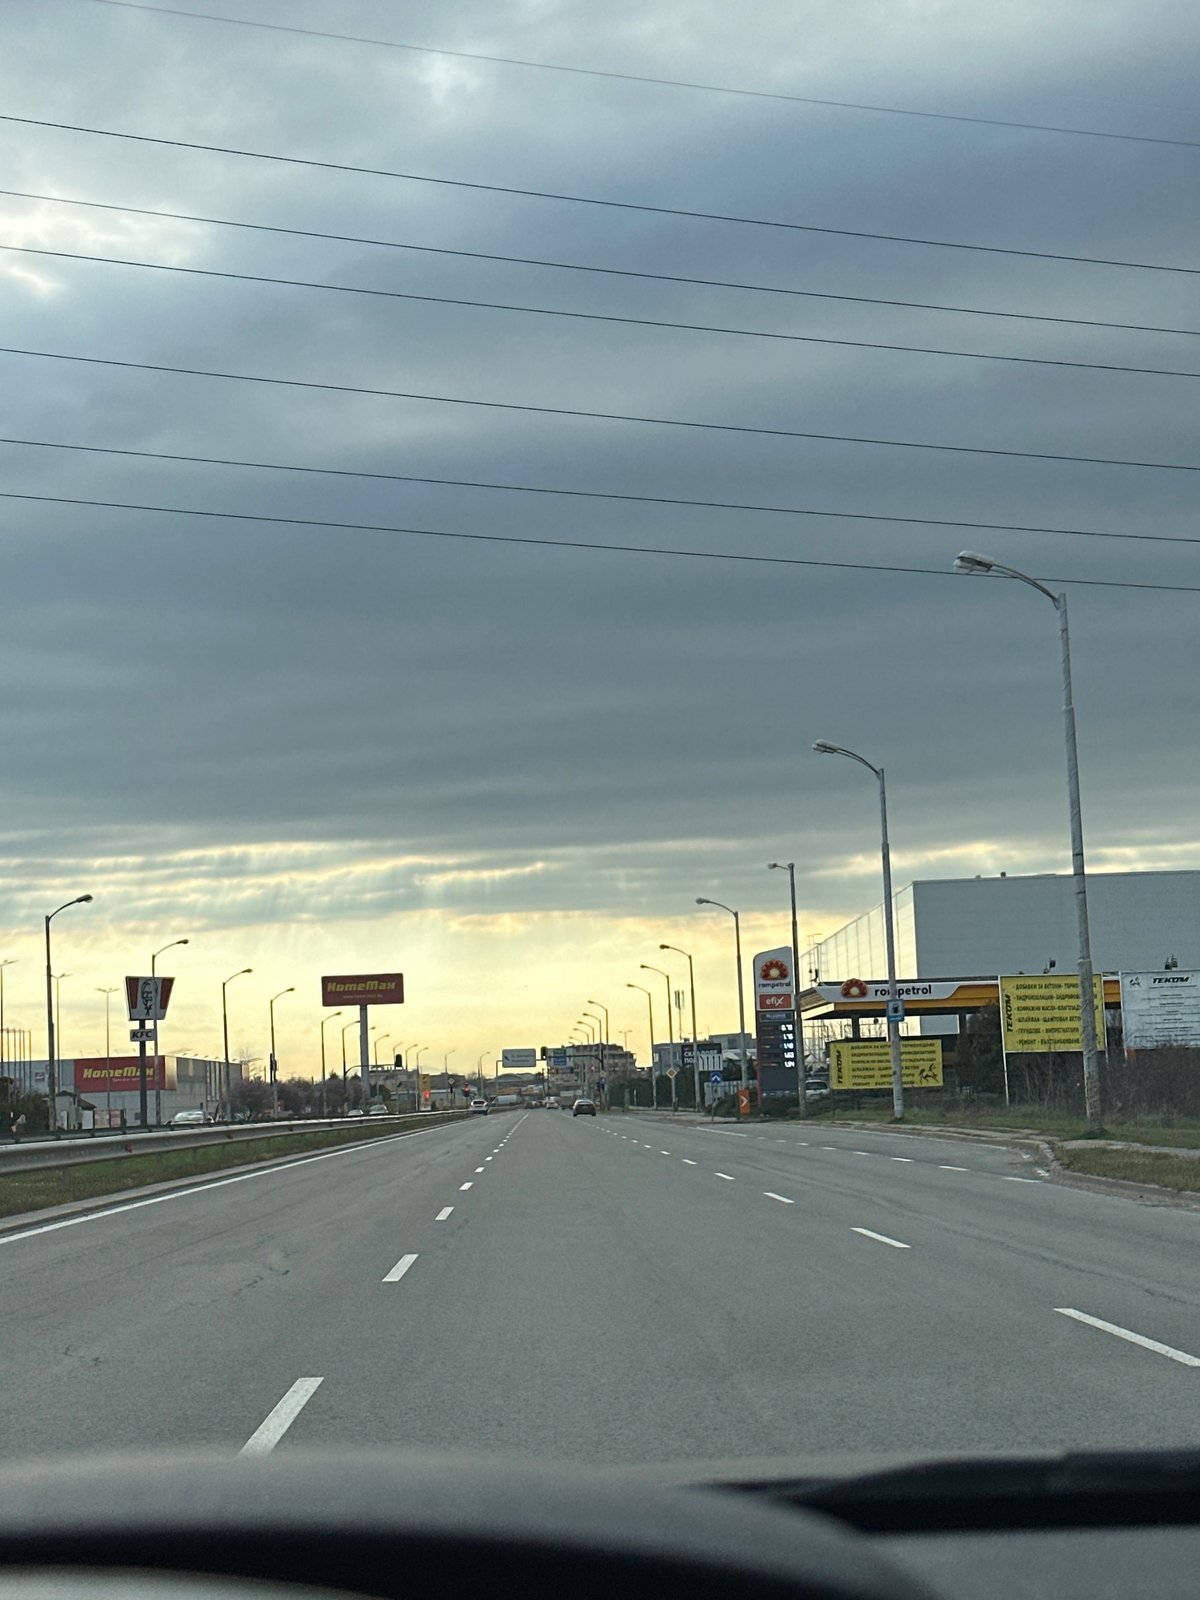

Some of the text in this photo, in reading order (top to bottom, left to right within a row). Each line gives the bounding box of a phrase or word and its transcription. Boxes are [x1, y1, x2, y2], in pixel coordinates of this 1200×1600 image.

[758, 981, 791, 989] rompetrol
[766, 996, 784, 1006] efix
[132, 1030, 152, 1039] KFC
